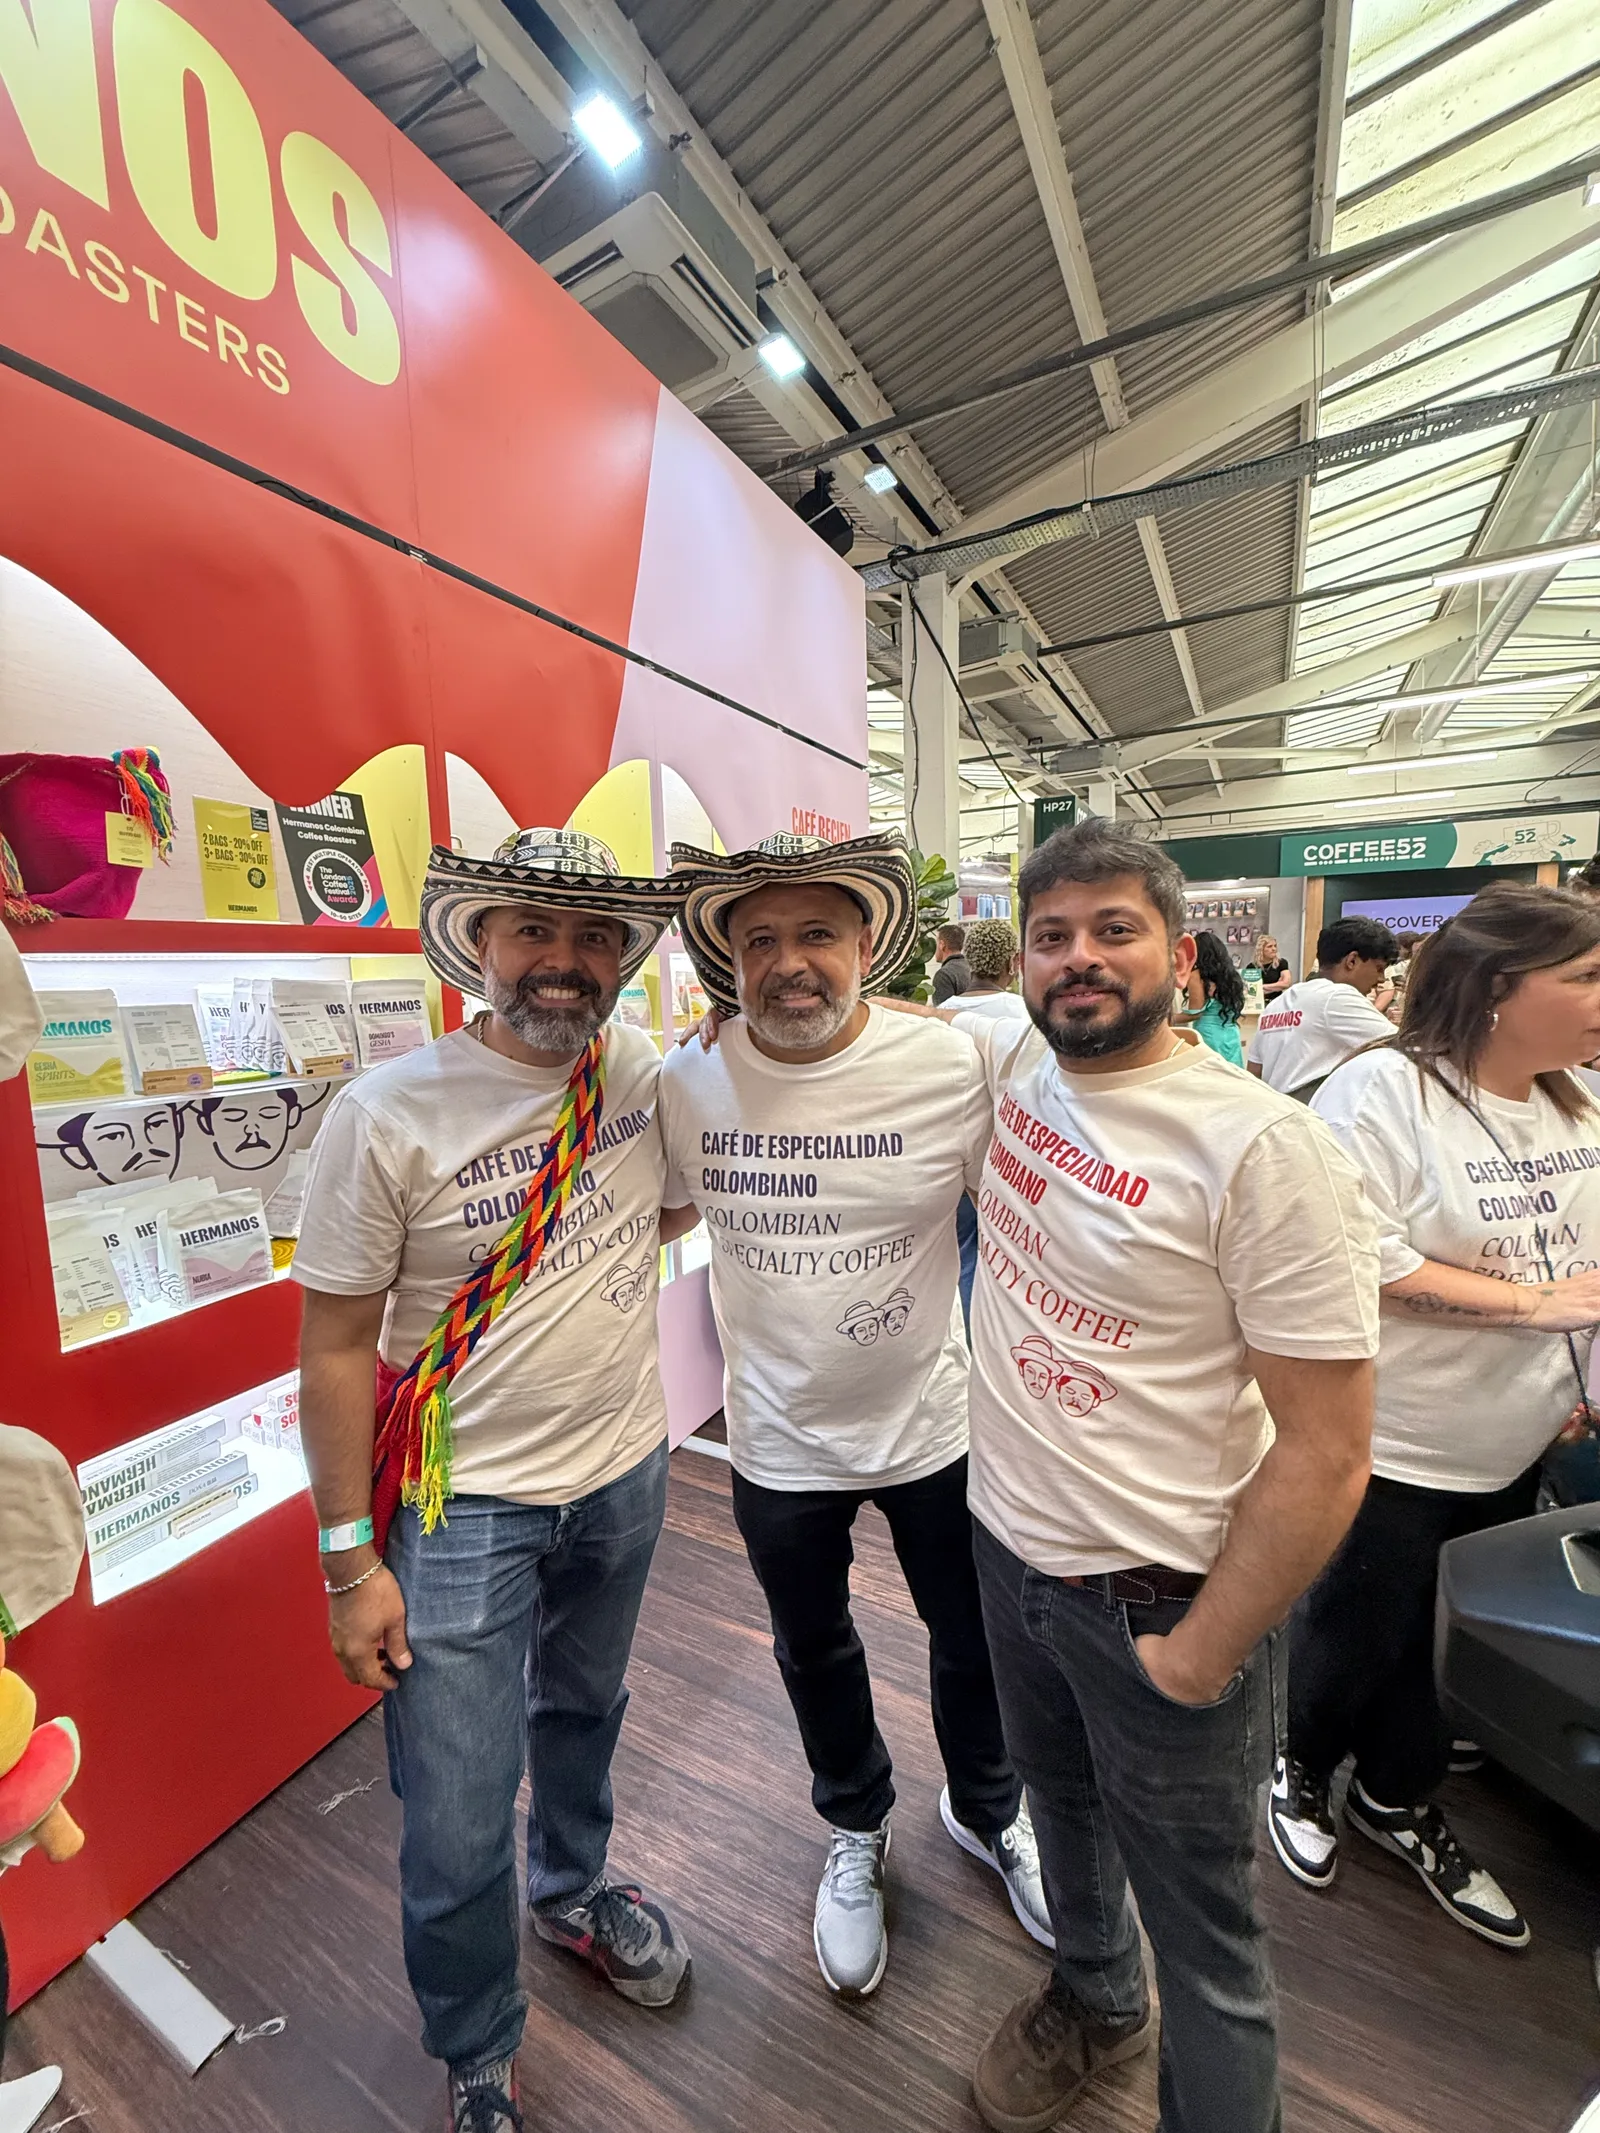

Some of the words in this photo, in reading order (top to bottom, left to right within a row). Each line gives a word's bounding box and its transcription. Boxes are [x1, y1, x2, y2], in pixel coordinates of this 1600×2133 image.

[290, 794, 354, 820] NNER
[1043, 801, 1072, 813] HP27
[282, 818, 324, 830] Hermanos
[325, 823, 365, 835] Colombian
[792, 807, 816, 836] CAFÉ
[203, 833, 208, 844] 2
[209, 834, 228, 847] BAGS
[233, 838, 250, 851] 20%
[251, 840, 263, 852] OFF
[298, 831, 323, 841] Coffee
[324, 835, 357, 845] Roasters
[1515, 828, 1536, 845] 52
[204, 847, 213, 859] 3+
[215, 848, 234, 861] BAGS
[239, 852, 256, 864] 30%
[257, 854, 268, 865] OFF
[313, 850, 336, 860] MULTIPLE
[337, 853, 365, 877] OPERATOR
[1303, 836, 1427, 867] COFFEE52
[319, 866, 332, 874] The
[320, 873, 346, 881] London
[322, 880, 348, 888] Coffee
[324, 887, 350, 896] Festival
[327, 895, 358, 904] Awards
[359, 999, 422, 1015] HERMANOS
[36, 1070, 76, 1082] SPIRITS
[701, 1129, 739, 1156] CAFÉ
[742, 1133, 764, 1159] DE
[768, 1132, 904, 1160] ESPECIALIDAD
[455, 1146, 510, 1189] CAFÉ
[513, 1144, 538, 1174] DE
[1012, 1108, 1032, 1141] DE
[1025, 1119, 1149, 1208] ESPECIALIDAD
[702, 1167, 818, 1199] COLOMBIANO
[463, 1169, 597, 1229] COLONO
[180, 1216, 260, 1247] HERMANOS
[468, 1189, 615, 1263] CMBIAN
[705, 1206, 842, 1236] COLOMBIAN
[829, 1234, 915, 1275] COFFEE
[1024, 1279, 1140, 1350] COFFEE
[95, 1490, 181, 1545] HERMANOS
